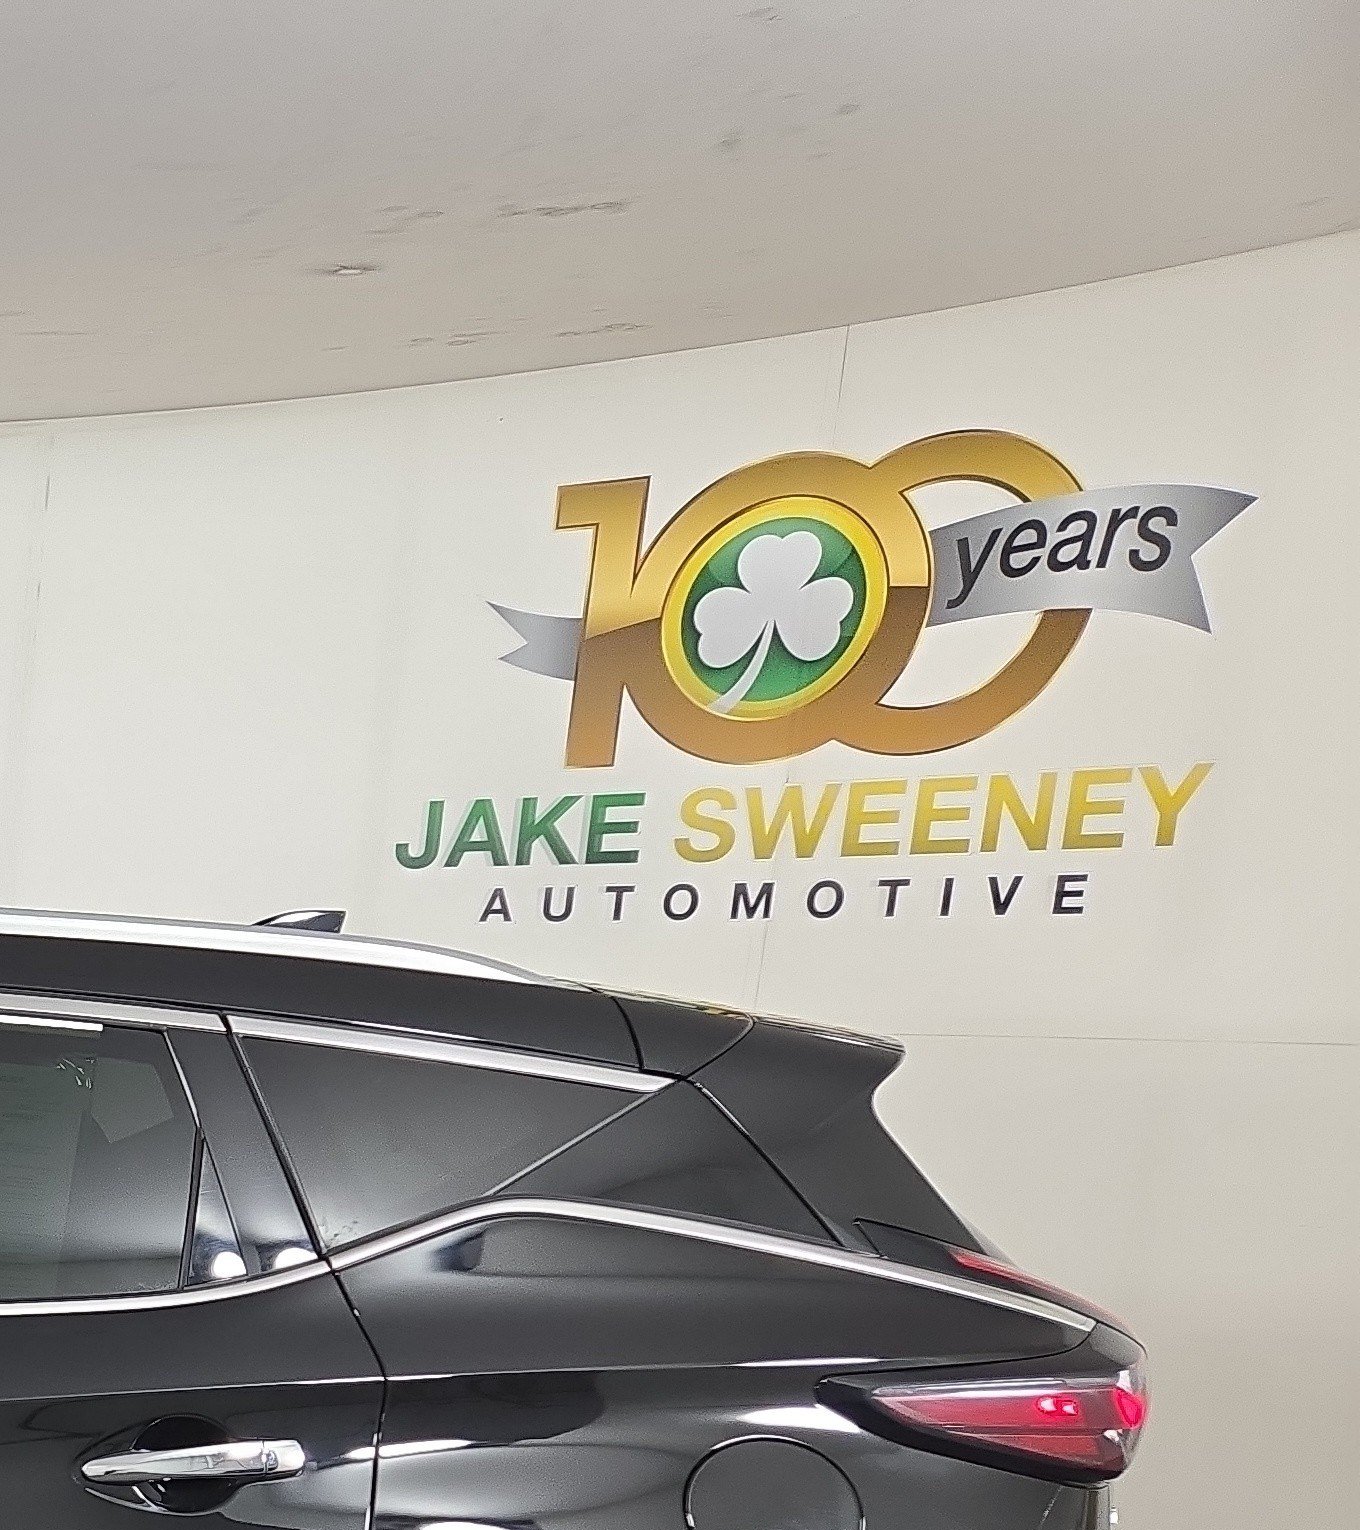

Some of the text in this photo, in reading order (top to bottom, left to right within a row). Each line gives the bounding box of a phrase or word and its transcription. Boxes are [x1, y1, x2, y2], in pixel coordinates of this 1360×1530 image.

[554, 429, 1092, 767] 100
[946, 504, 1178, 608] years
[394, 762, 1214, 869] JAKE SWEENEY
[479, 873, 1090, 923] AUTOMOTIVE
